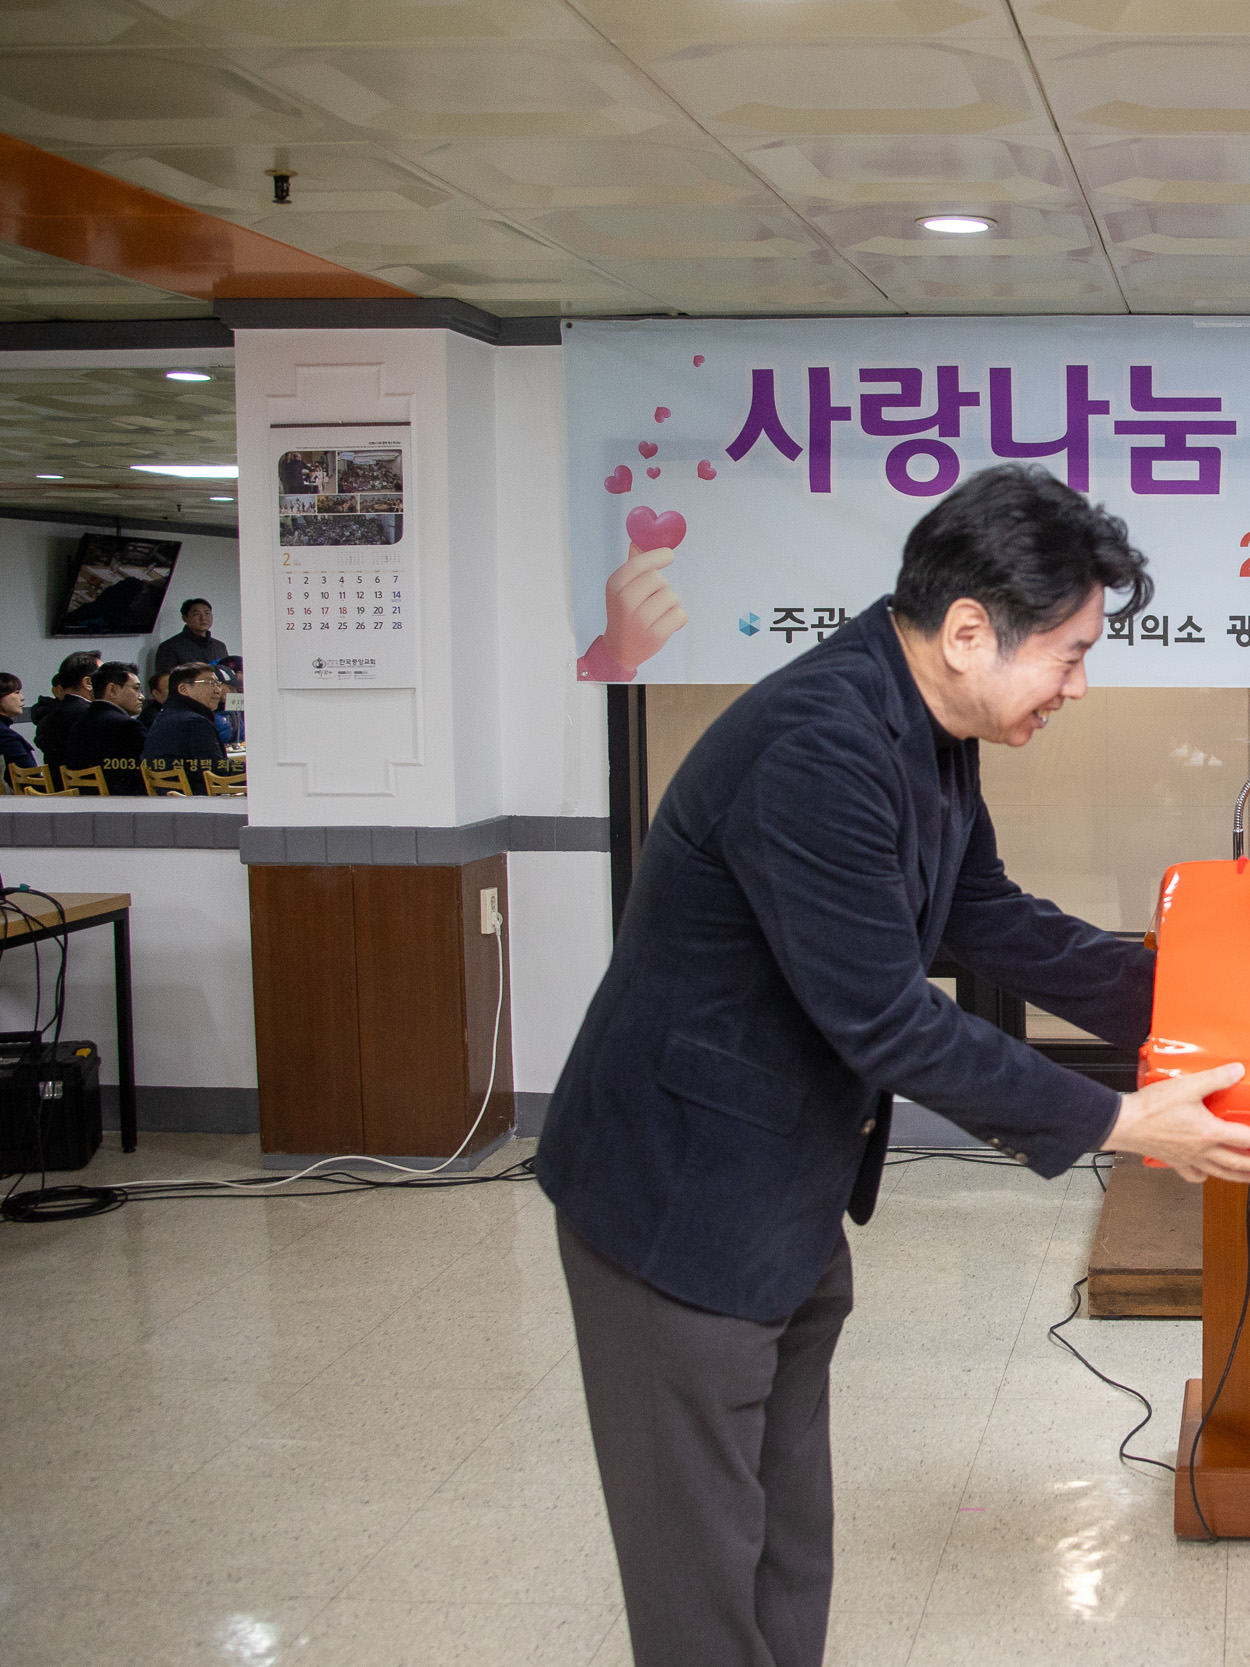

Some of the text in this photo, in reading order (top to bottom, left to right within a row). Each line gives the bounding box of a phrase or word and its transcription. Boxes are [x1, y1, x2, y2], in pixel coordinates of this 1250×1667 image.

[724, 364, 1237, 497] 사랑나눔
[283, 552, 291, 566] 2
[321, 576, 327, 584] 3
[339, 576, 344, 584] 4
[357, 576, 362, 584] 5
[287, 592, 292, 600] 8
[357, 591, 364, 599] 12
[374, 591, 382, 599] 13
[393, 591, 401, 599] 14
[287, 607, 294, 615] 15
[304, 607, 312, 615] 16
[321, 607, 329, 615] 17
[392, 606, 401, 614] 21
[320, 622, 330, 630] 24
[338, 622, 348, 630] 25
[392, 622, 402, 630] 28
[103, 758, 166, 770] 2003.4.19
